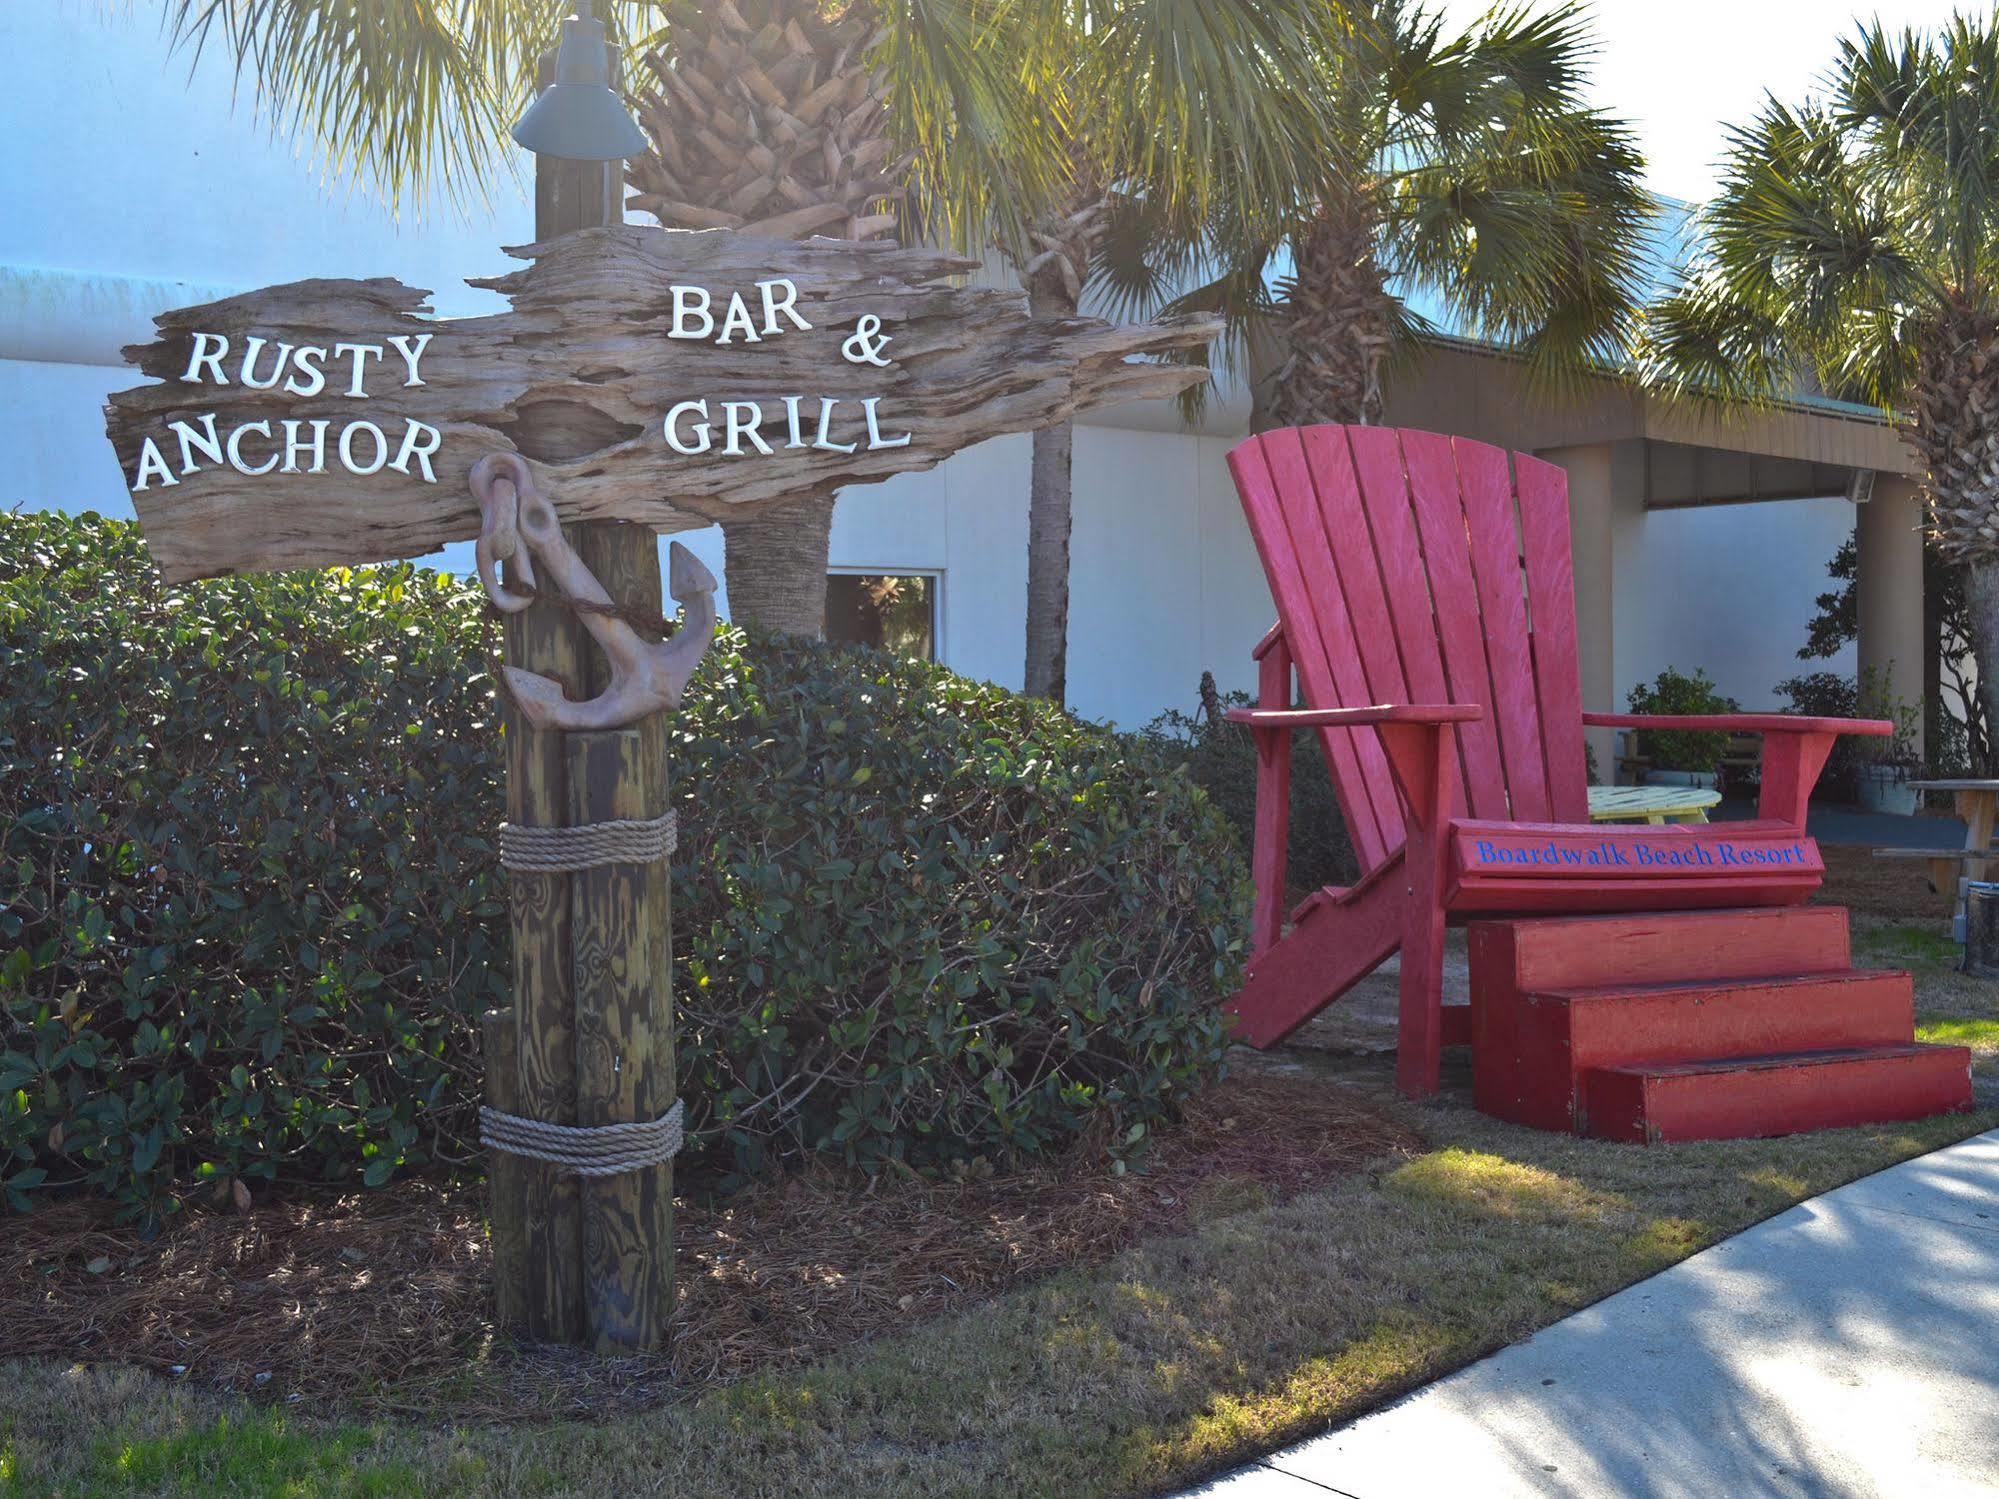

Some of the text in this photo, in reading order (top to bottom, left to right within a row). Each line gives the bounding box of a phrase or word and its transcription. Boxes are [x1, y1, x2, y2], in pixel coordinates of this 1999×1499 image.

[667, 278, 893, 367] BAR &
[179, 332, 434, 398] RUSTY
[132, 413, 442, 492] ANCHOR
[663, 396, 912, 455] GRILL
[1475, 840, 1805, 866] Boardwalk Beach Resort
